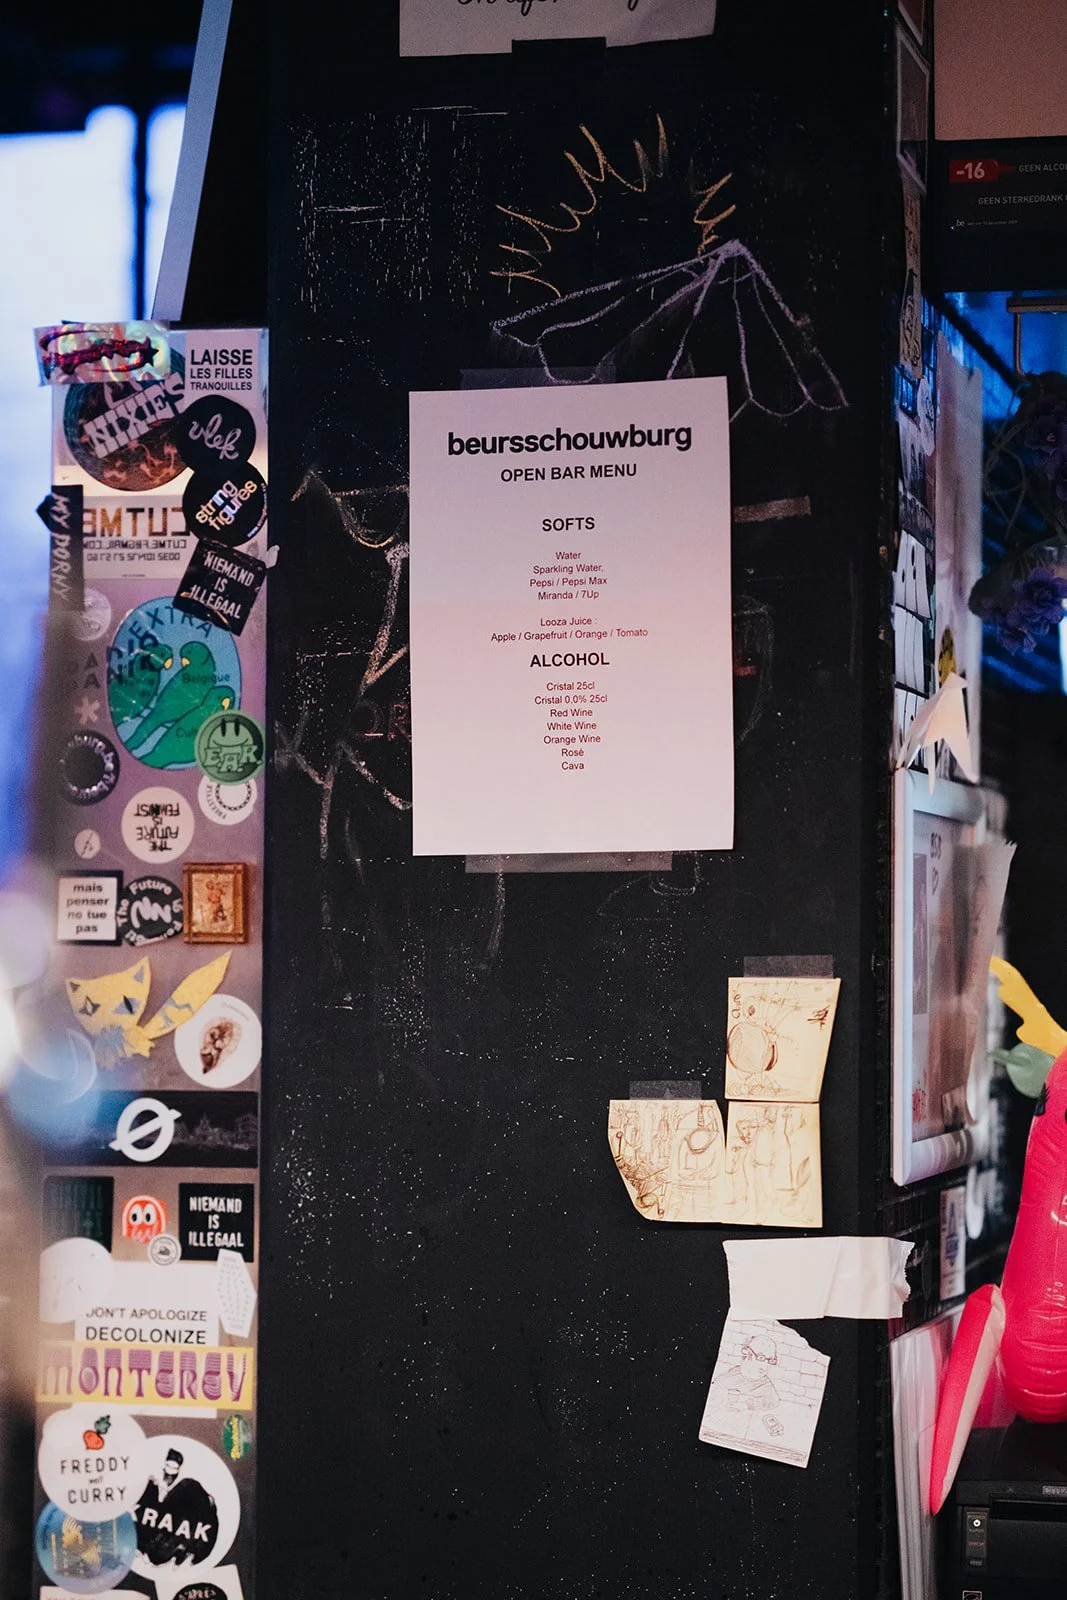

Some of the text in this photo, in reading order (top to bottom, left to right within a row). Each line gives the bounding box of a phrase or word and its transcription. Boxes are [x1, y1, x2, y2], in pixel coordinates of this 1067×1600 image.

[956, 161, 985, 180] -16
[1019, 164, 1040, 172] GEEN
[978, 197, 1000, 205] GEEN
[1003, 194, 1063, 204] STERKEDRANK
[190, 349, 253, 365] LAISSE
[190, 368, 253, 379] LES FILLES
[190, 381, 253, 391] TRANQUILLES
[448, 424, 691, 456] beursschouwburg
[501, 464, 637, 482] OPEN BAR MENU
[195, 480, 238, 524] string
[208, 480, 258, 531] figures
[542, 517, 595, 531] SOFTS
[555, 551, 581, 560] Water
[533, 565, 573, 575] Sparkling
[214, 577, 228, 593] IS
[530, 577, 607, 588] Pepsi / Pepsi Max
[538, 590, 599, 600] Miranda / 7Up
[190, 584, 242, 619] ILLEGAAL
[129, 606, 213, 643] EXTRA
[540, 618, 567, 627] Looza
[569, 617, 592, 626] Juice
[491, 628, 648, 643] Apple / Grapefruit / Orange / Tomato
[530, 652, 610, 667] ALCOHOL
[547, 681, 595, 691] Cristal 25cl
[534, 695, 562, 704] Cristal
[589, 694, 607, 703] 25cl
[550, 708, 592, 717] Red Wine
[547, 721, 597, 730] White Wine
[544, 734, 601, 745] Orange Wine
[561, 747, 584, 757] Rosé
[561, 761, 584, 770] Cava
[152, 815, 163, 826] IS
[73, 883, 103, 893] mais
[66, 897, 109, 907] penser
[117, 898, 129, 927] The
[129, 880, 171, 895] Future
[75, 924, 98, 935] pas
[208, 1214, 220, 1230] IS
[188, 1231, 245, 1248] ILLEGAAL
[130, 1308, 208, 1322] APOLOGIZE
[85, 1326, 207, 1345] DECOLONIZE
[60, 1456, 130, 1474] FREDDY
[67, 1487, 127, 1504] CURRY
[131, 1503, 213, 1542] KRAAK
